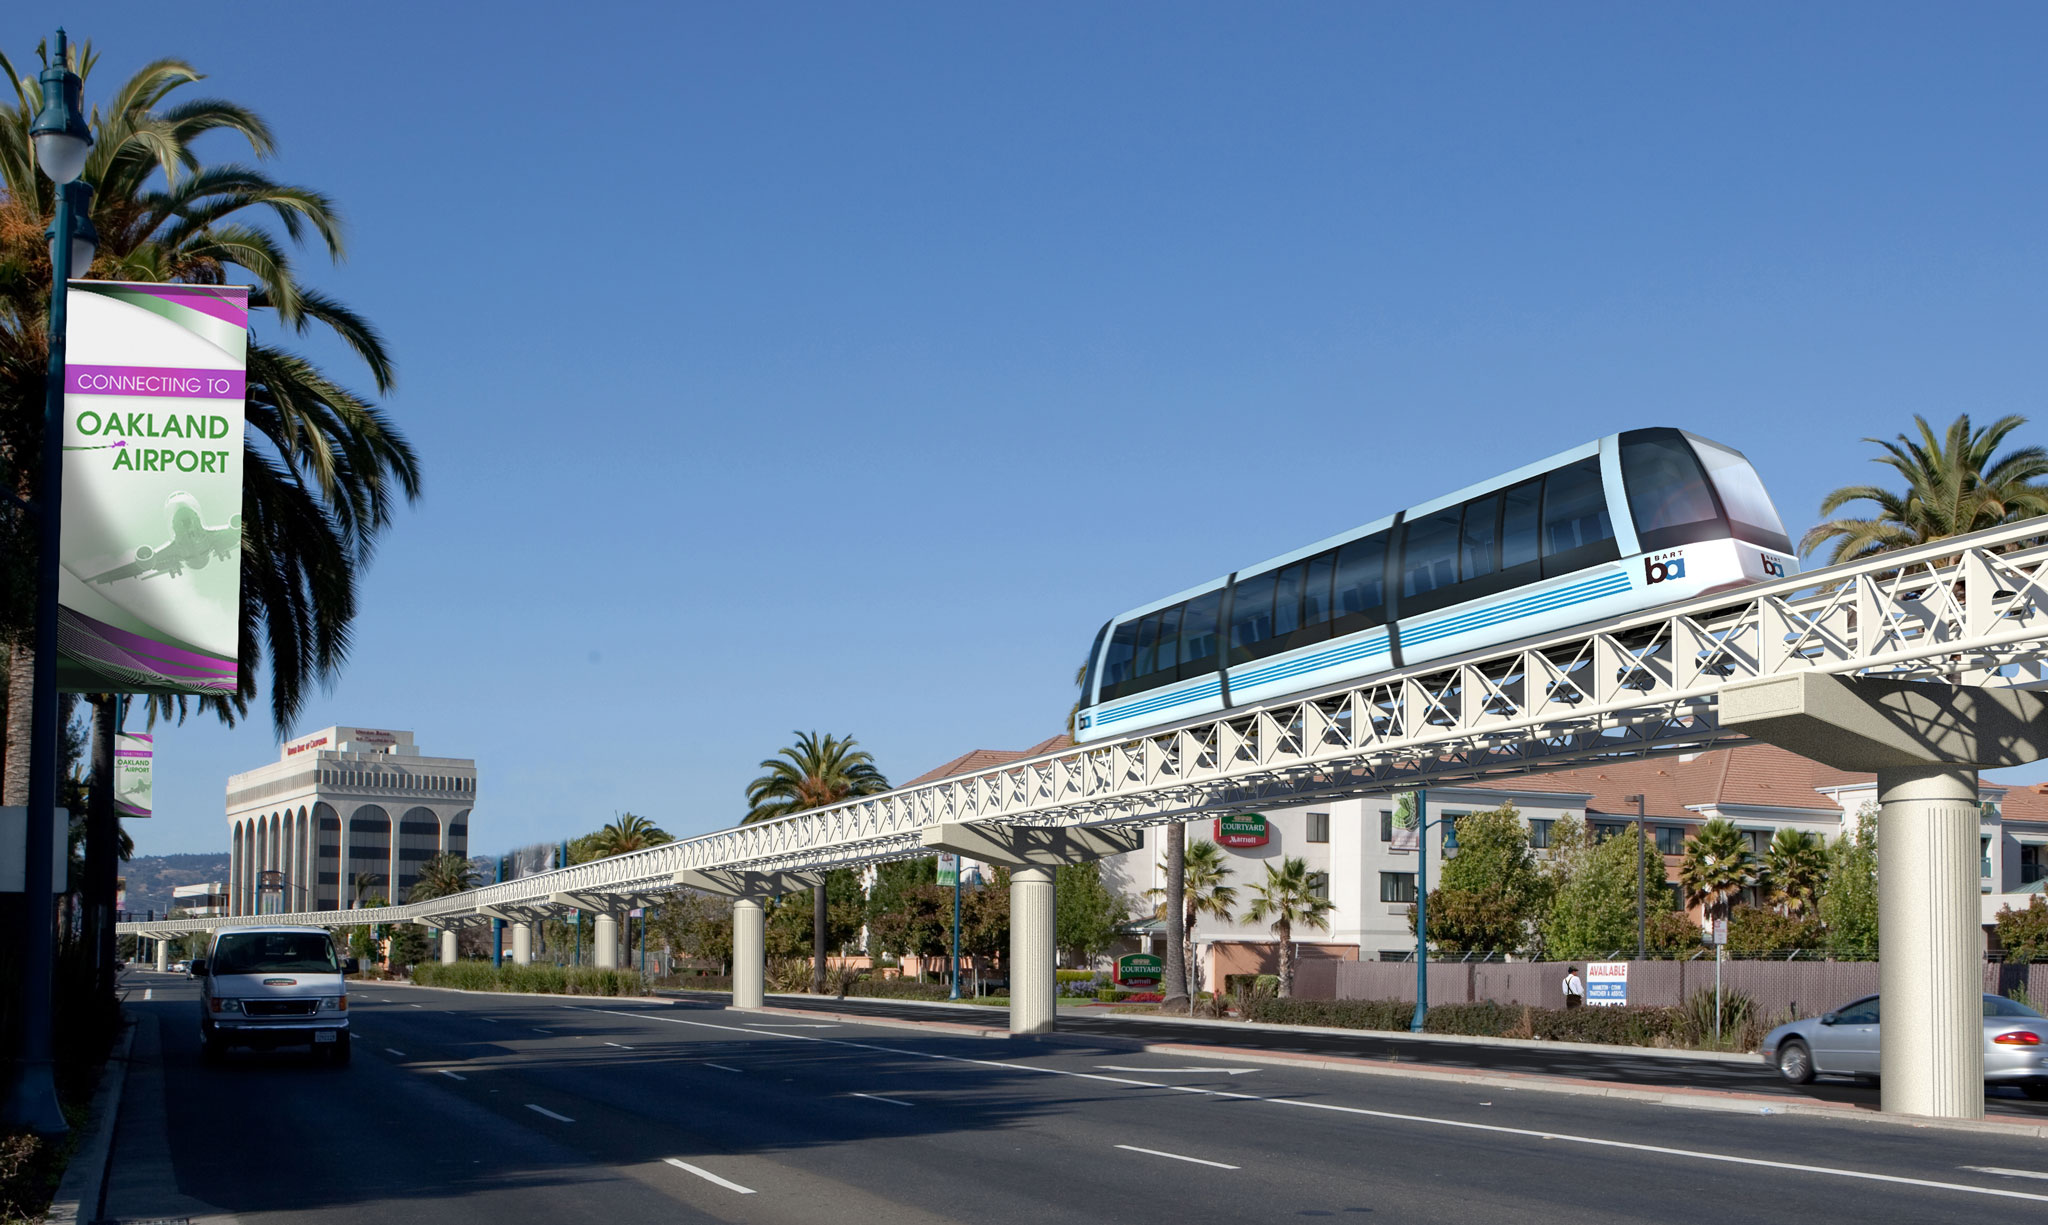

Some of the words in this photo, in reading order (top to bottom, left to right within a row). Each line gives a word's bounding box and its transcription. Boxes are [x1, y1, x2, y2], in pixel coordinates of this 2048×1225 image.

[78, 373, 201, 393] CONNECTING
[207, 378, 230, 394] TO
[76, 411, 229, 439] OAKLAND
[112, 448, 229, 473] AIRPORT
[1654, 550, 1684, 561] BART
[1221, 823, 1265, 832] COURTYARD
[1229, 836, 1256, 844] Marriott
[1121, 965, 1161, 973] COURTYARD
[1589, 965, 1625, 976] AVAILABLE
